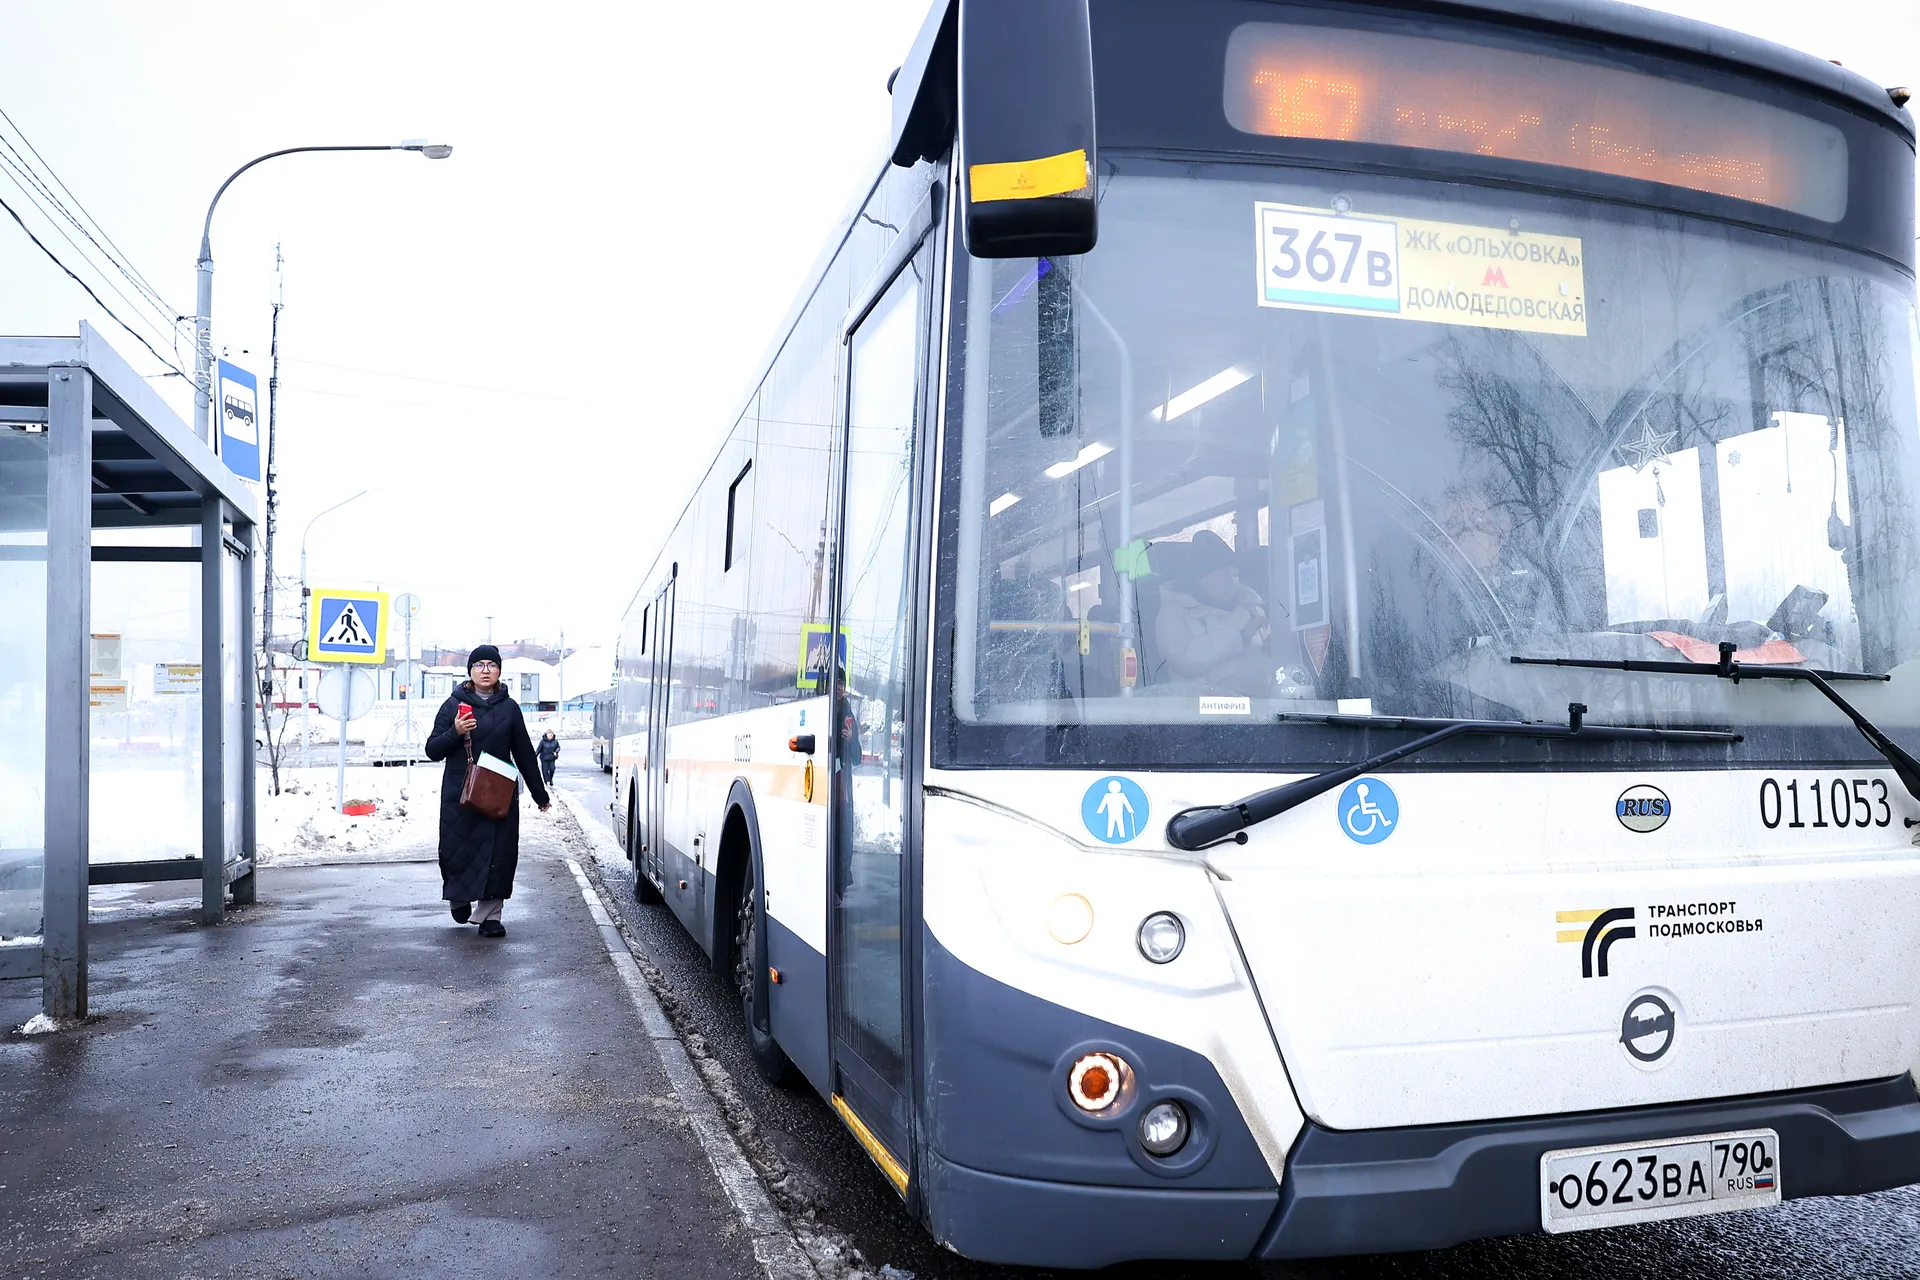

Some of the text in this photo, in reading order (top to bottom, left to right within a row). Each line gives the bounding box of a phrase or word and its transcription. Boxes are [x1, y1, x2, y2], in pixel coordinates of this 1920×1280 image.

[1405, 228, 1581, 268] ЖК «ОЛЬХОВКА»
[1406, 286, 1585, 323] ДОМОДЕДОВСКАЯ
[1201, 702, 1246, 711] АНТИФРИЗ
[1622, 798, 1665, 817] RUS
[1759, 777, 1892, 829] 011053
[1648, 901, 1736, 918] ТРАНСПОРТ
[1649, 918, 1763, 938] ПОДМОСКОВЬЯ
[1714, 1140, 1766, 1179] 790
[1727, 1176, 1754, 1191] RUS
